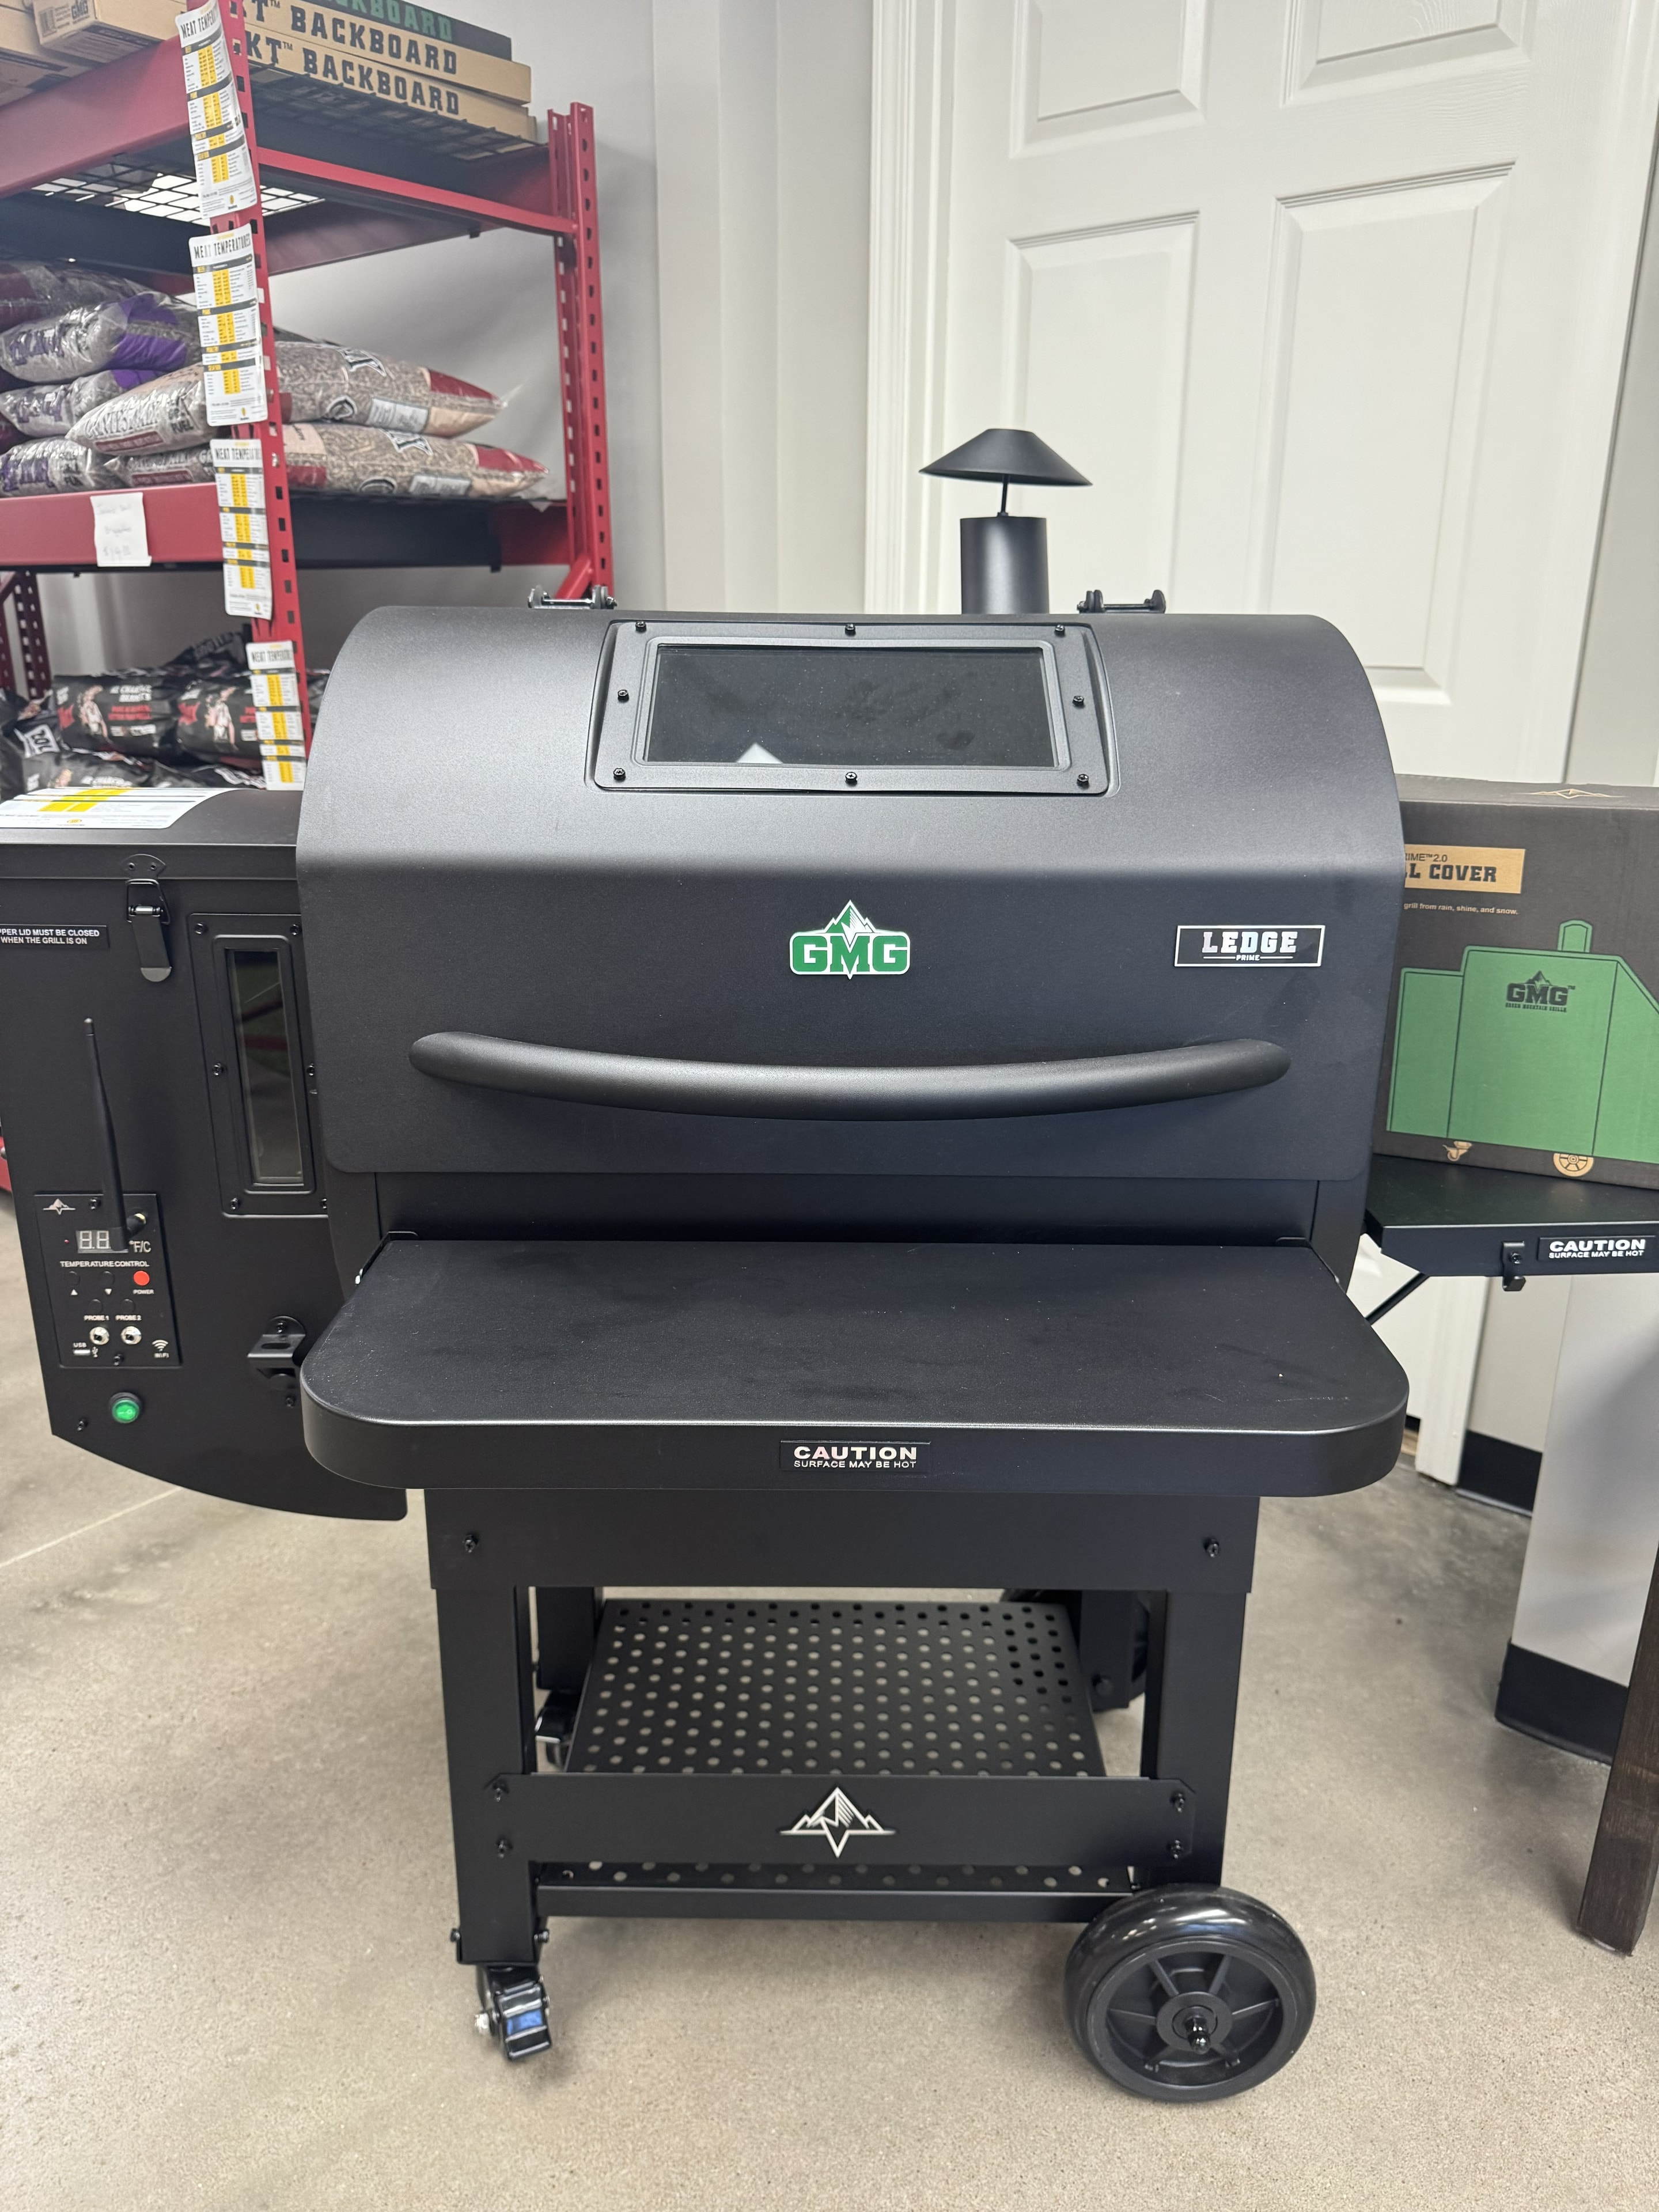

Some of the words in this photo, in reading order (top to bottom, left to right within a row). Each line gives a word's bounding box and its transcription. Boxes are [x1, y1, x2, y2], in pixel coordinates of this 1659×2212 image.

[290, 5, 457, 75] BACKBOARD
[302, 47, 459, 115] BACKBOARD
[194, 244, 211, 259] MEAT
[1405, 863, 1421, 879] L
[1429, 864, 1497, 882] COVER
[1202, 931, 1298, 953] LEDGE
[791, 933, 909, 975] GMG
[1550, 1239, 1646, 1252] CAUTION
[794, 1446, 917, 1460] CAUTION
